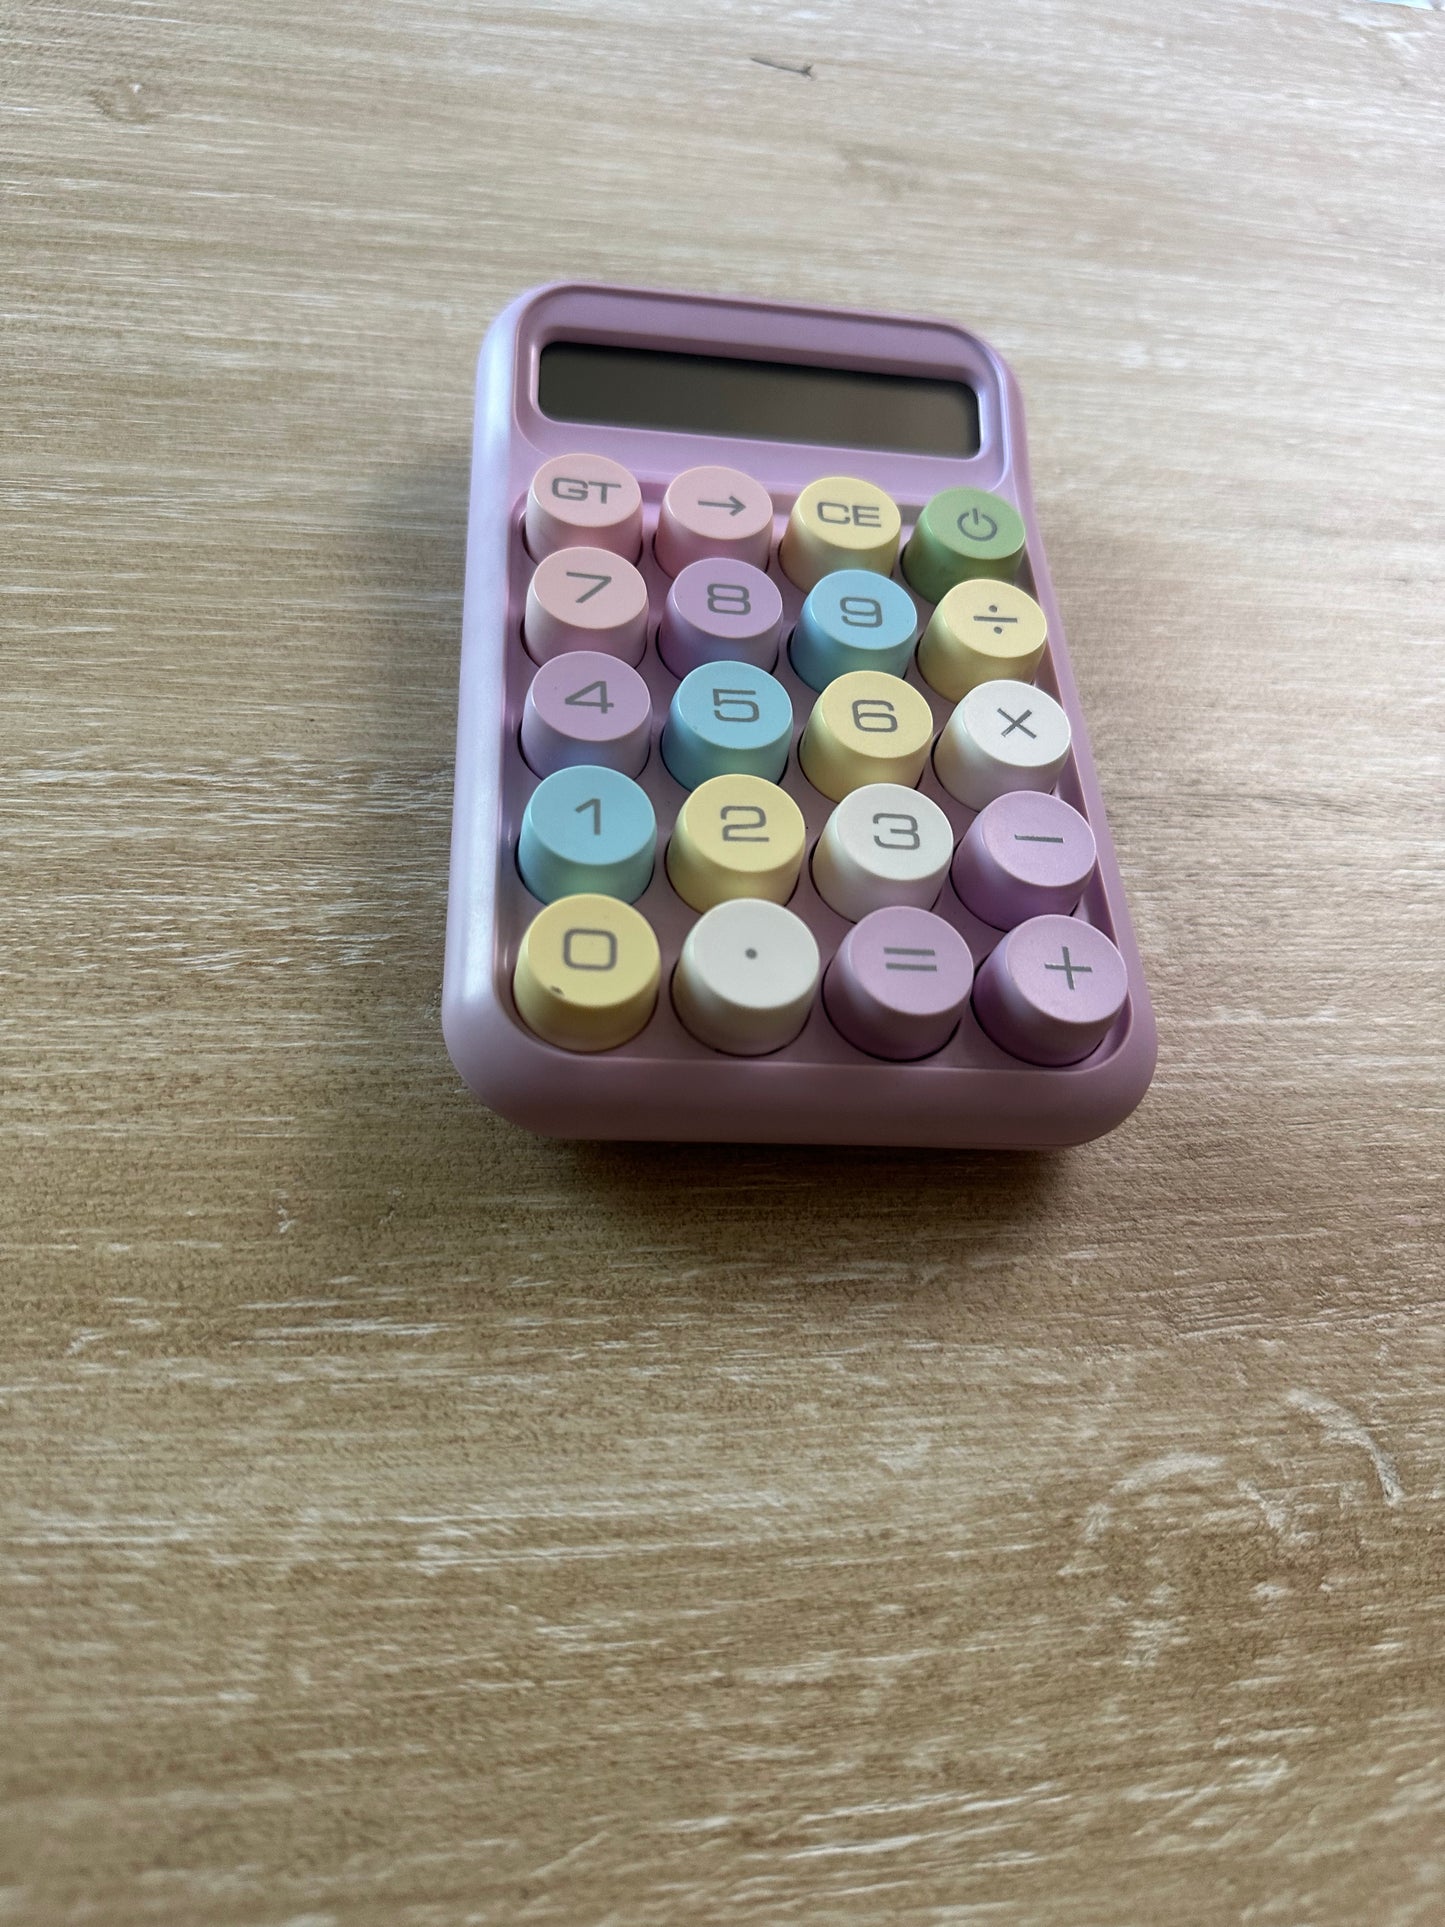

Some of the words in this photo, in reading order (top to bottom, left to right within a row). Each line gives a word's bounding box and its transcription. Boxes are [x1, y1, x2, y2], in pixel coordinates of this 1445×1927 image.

[551, 476, 622, 504] GT
[816, 500, 882, 528] CE
[565, 570, 613, 604] 7
[706, 582, 752, 616] 8
[839, 596, 884, 629] 9
[973, 604, 1019, 635] ÷
[564, 680, 615, 714] 4
[712, 688, 760, 723] 5
[851, 699, 899, 733] 6
[574, 797, 601, 836] 1
[719, 805, 770, 843] 2
[872, 812, 921, 851] 3
[562, 927, 618, 972] 0
[883, 947, 938, 972] =
[1044, 945, 1093, 991] +
